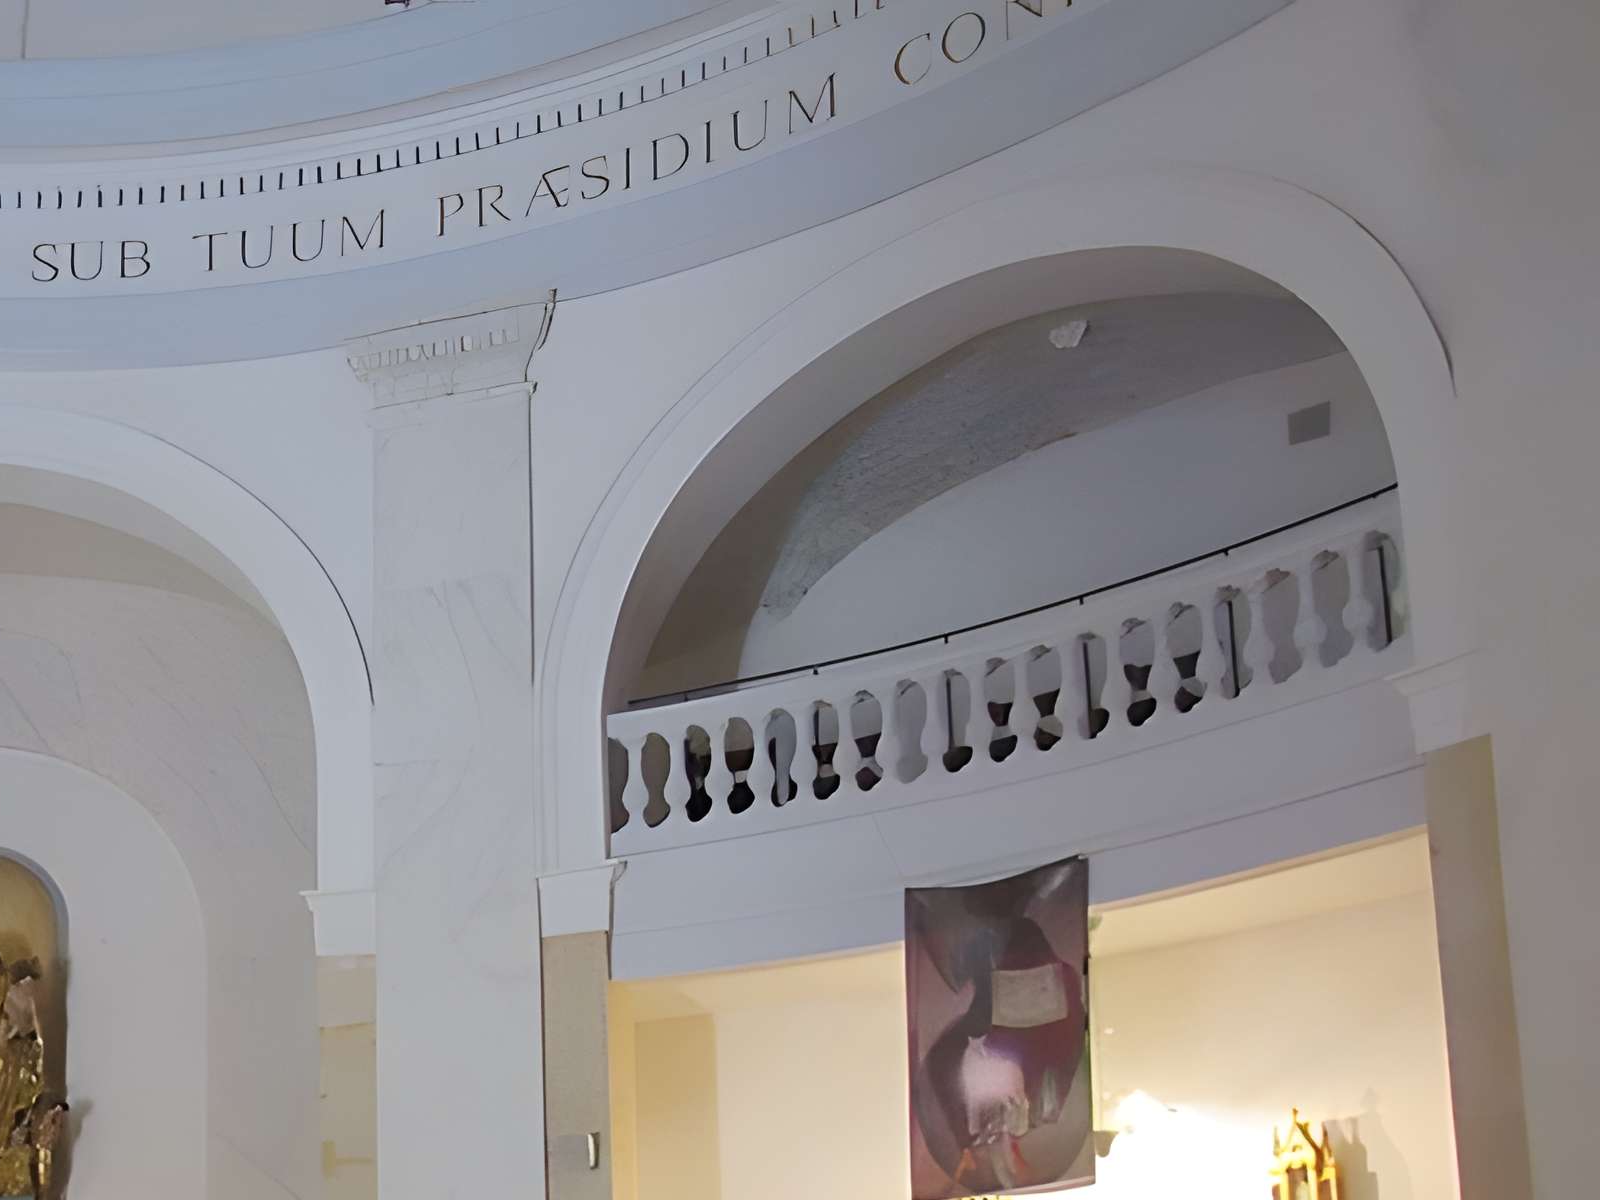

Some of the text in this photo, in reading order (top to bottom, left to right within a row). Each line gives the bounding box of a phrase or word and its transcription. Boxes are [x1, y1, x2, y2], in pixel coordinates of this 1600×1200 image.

[31, 240, 152, 283] SUB
[193, 209, 386, 272] TUUM
[437, 73, 837, 237] PRÆSIDIUM
[894, 0, 1073, 85] CON
